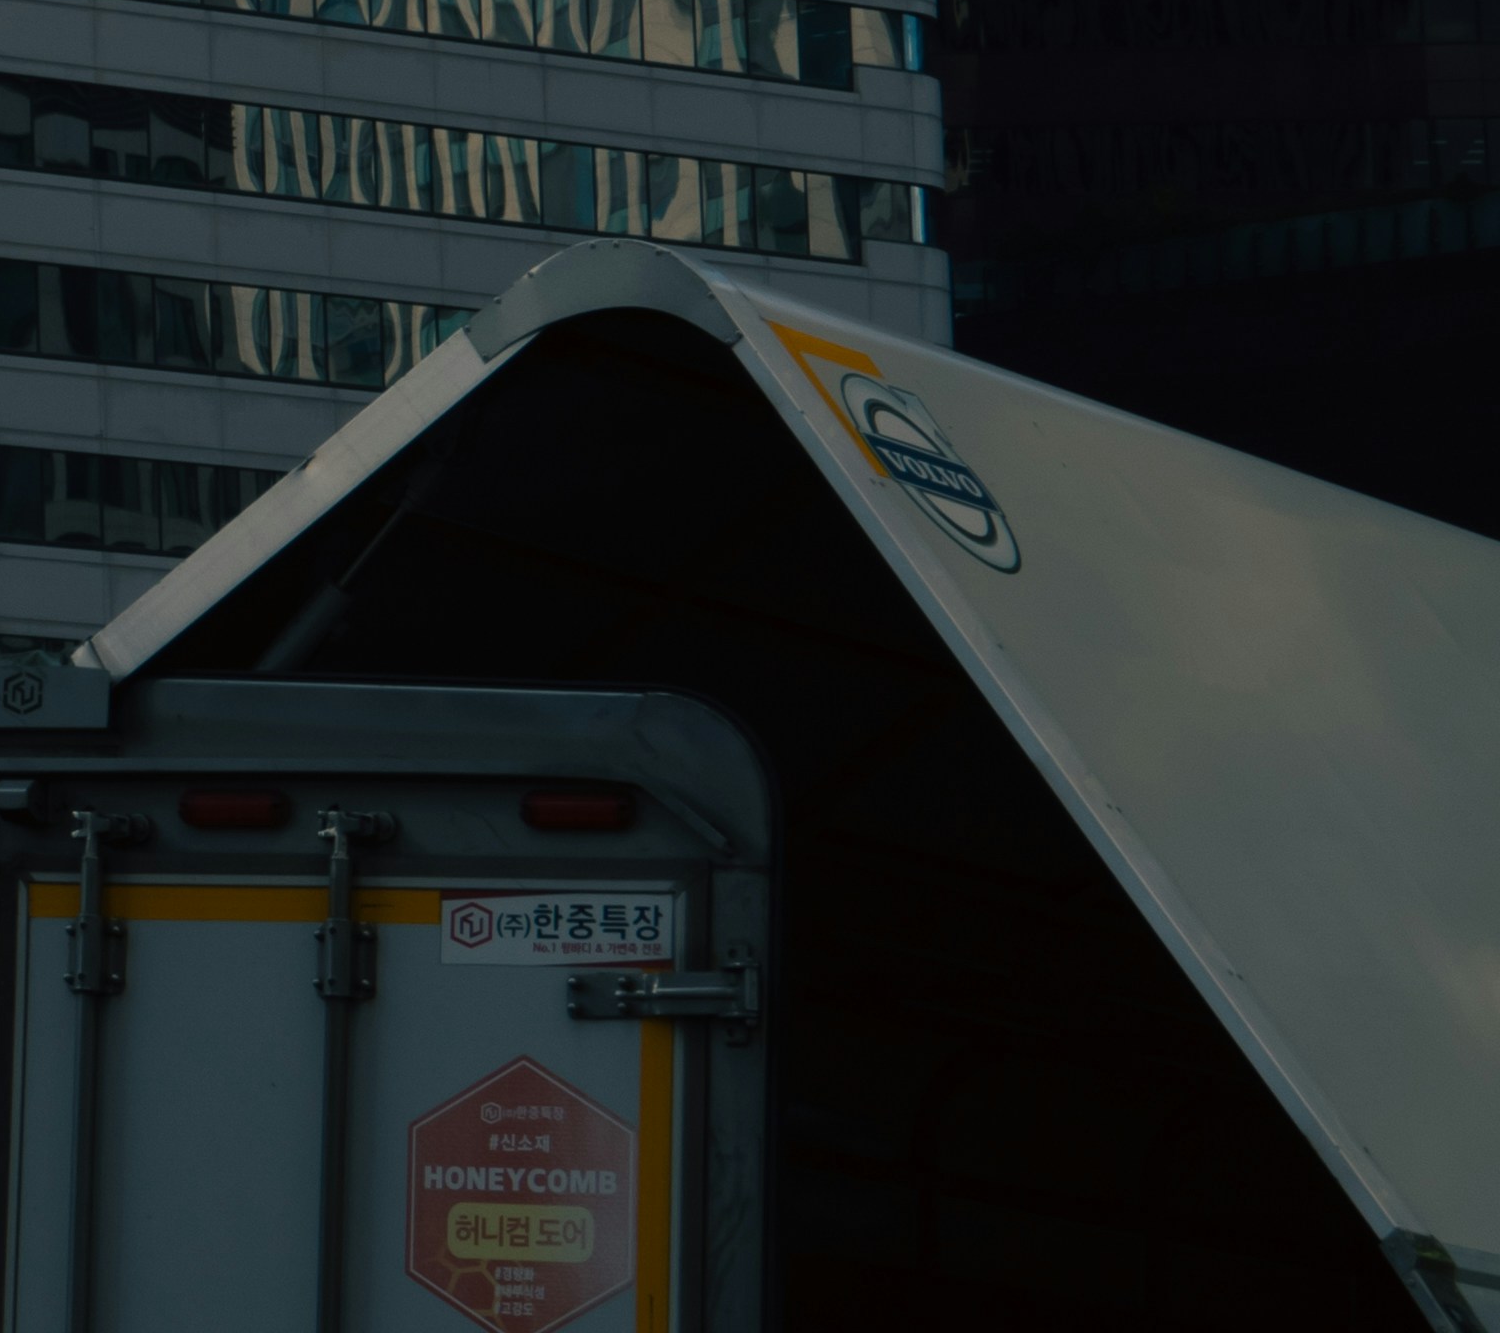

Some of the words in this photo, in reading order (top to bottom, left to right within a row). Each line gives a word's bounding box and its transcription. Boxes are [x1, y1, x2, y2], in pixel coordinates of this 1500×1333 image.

[876, 445, 983, 498] VOLVO
[497, 904, 663, 941] (주)한중특장
[533, 942, 556, 953] No.1
[489, 1134, 551, 1153] #신소재
[424, 1165, 617, 1194] HONEYCOMB
[455, 1215, 530, 1248] 허니컴
[535, 1218, 587, 1250] 도어
